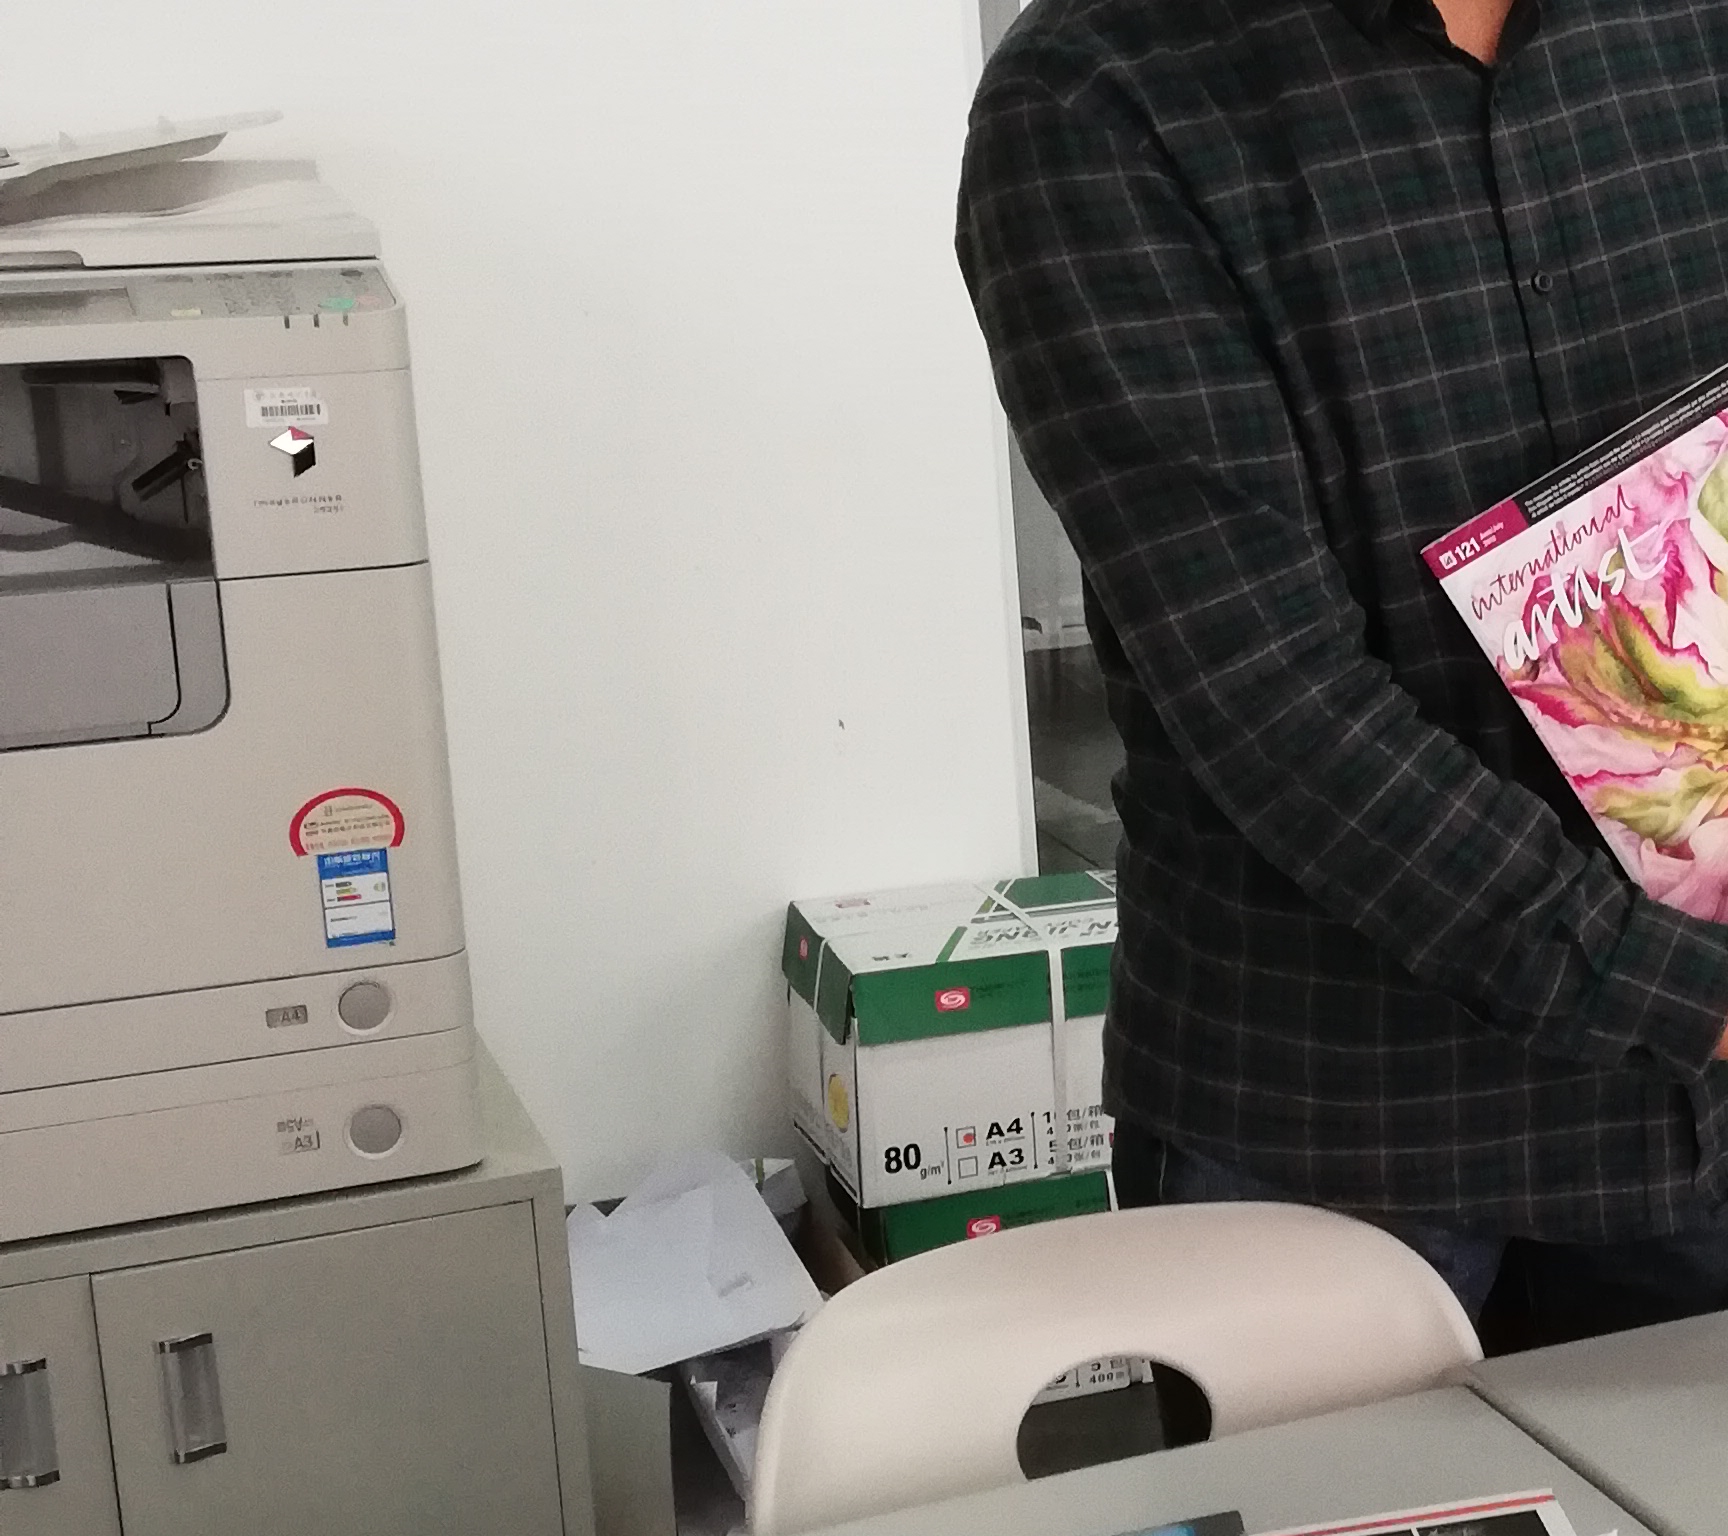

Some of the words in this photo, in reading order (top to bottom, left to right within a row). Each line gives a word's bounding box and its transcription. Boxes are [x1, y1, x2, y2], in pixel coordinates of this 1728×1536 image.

[1454, 535, 1481, 565] 121
[1471, 484, 1640, 621] international
[1503, 517, 1692, 671] artist
[986, 1117, 1023, 1140] A4
[884, 1143, 921, 1174] 80
[988, 1147, 1025, 1170] A3
